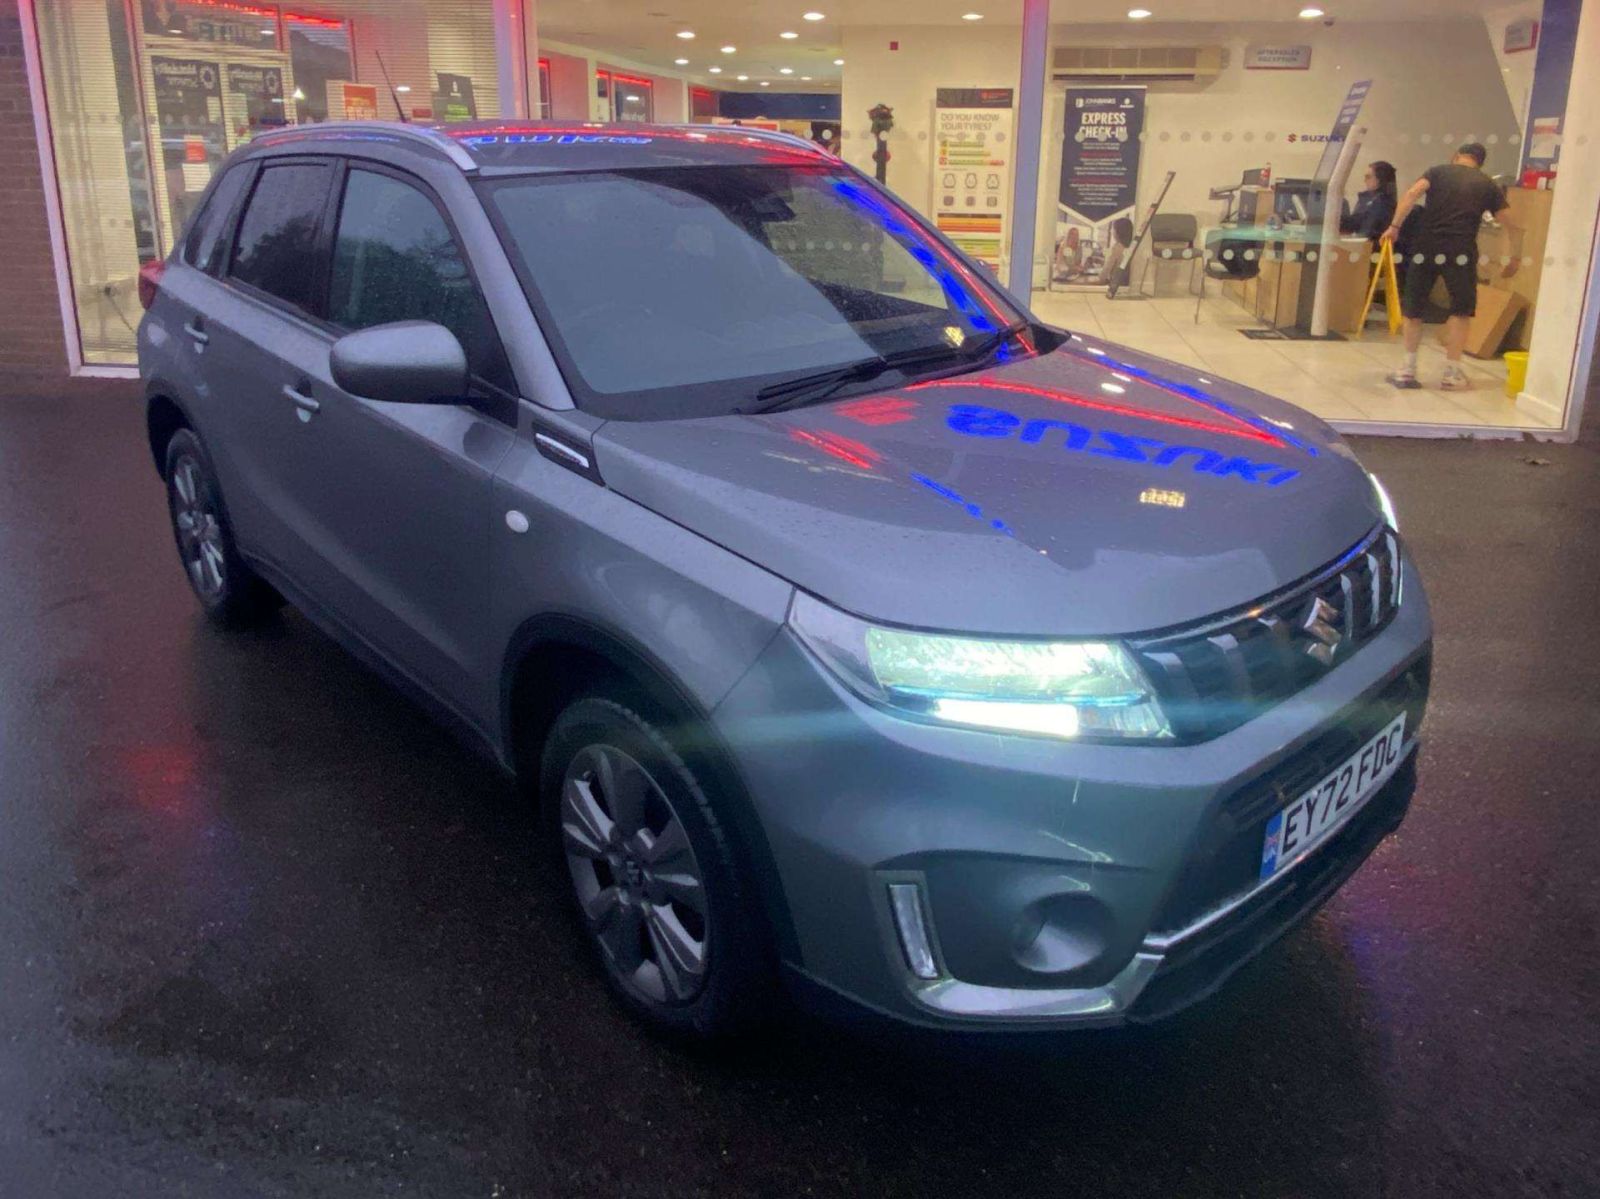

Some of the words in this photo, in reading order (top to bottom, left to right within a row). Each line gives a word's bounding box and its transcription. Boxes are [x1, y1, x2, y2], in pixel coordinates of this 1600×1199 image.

[941, 113, 954, 121] DO
[956, 113, 972, 121] YOU
[974, 113, 999, 121] KNOW
[1082, 112, 1126, 125] EXPRESS
[941, 122, 962, 131] YOUR
[1079, 126, 1127, 139] CHECK-IN
[1282, 777, 1353, 855] EY72
[1356, 724, 1401, 794] FDC
